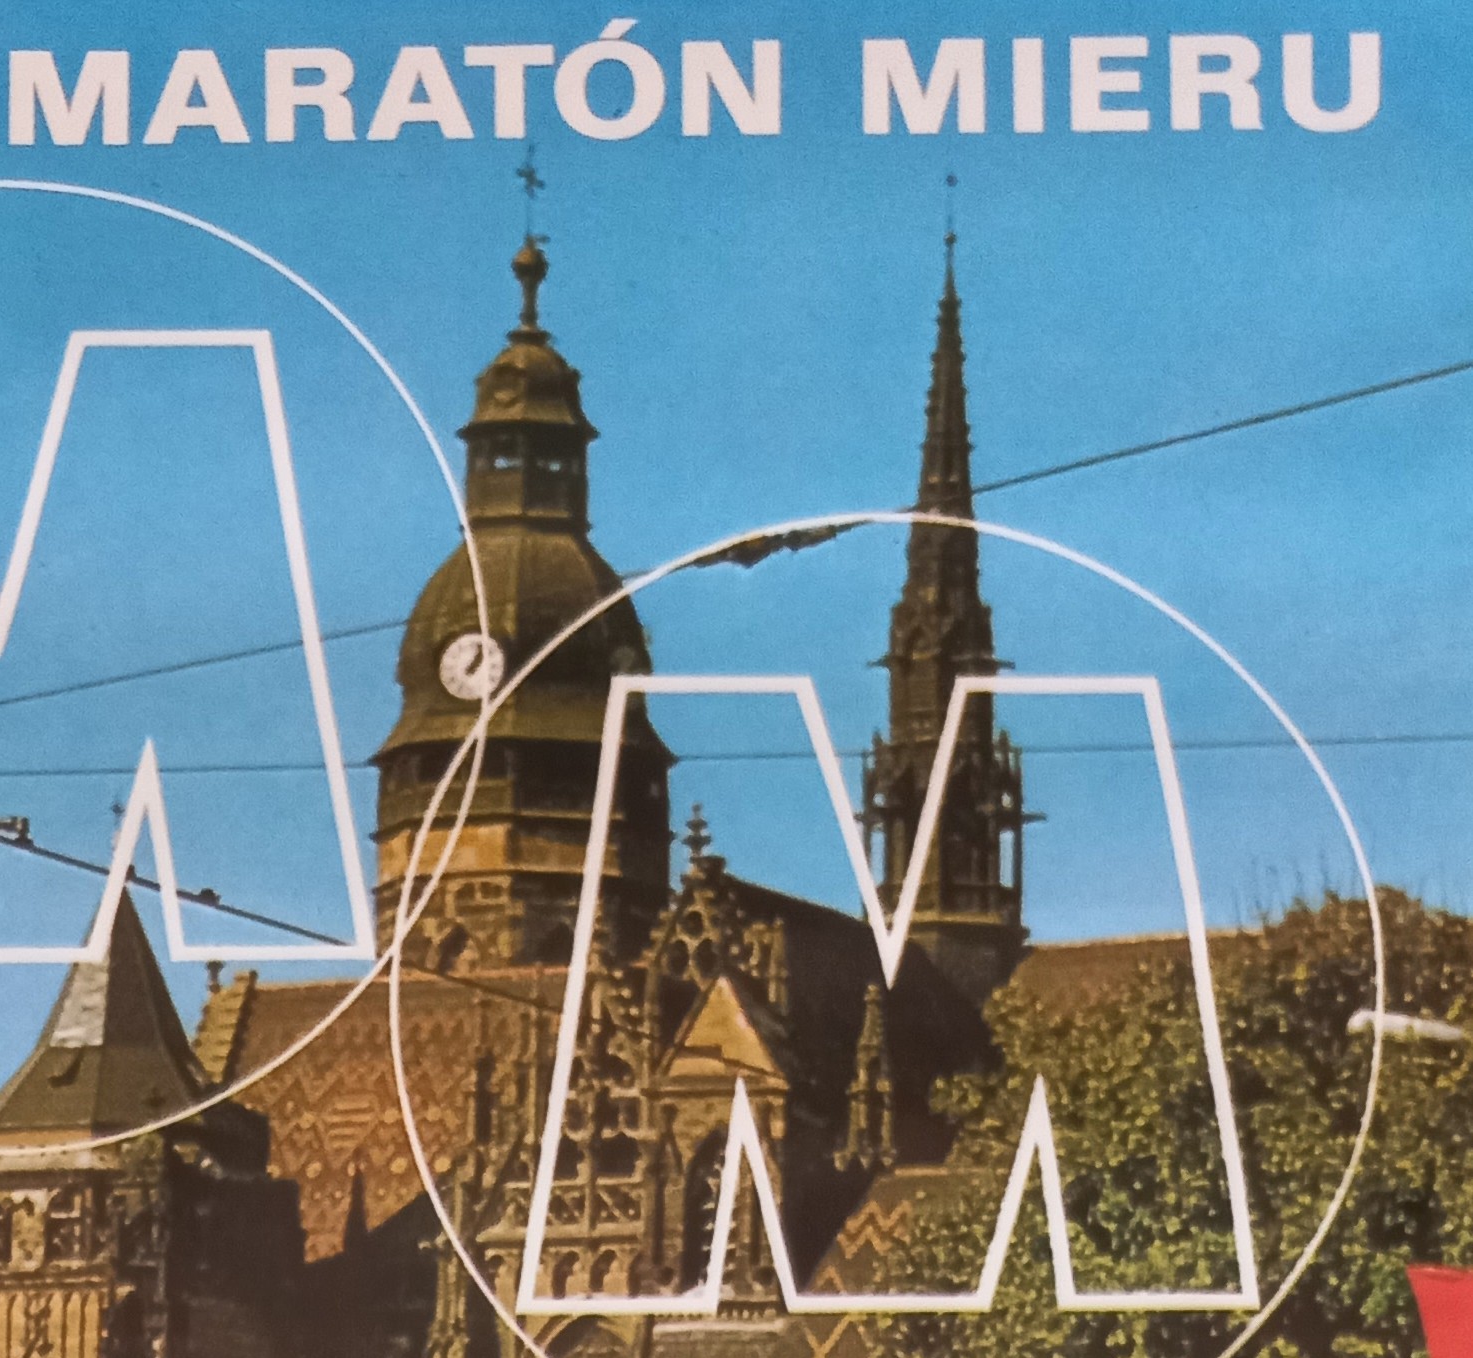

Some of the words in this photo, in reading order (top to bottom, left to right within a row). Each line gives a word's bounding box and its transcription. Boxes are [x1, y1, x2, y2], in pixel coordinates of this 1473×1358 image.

[7, 19, 782, 146] MARATÓN
[861, 32, 1382, 135] MIERU
[517, 674, 1261, 1312] M
